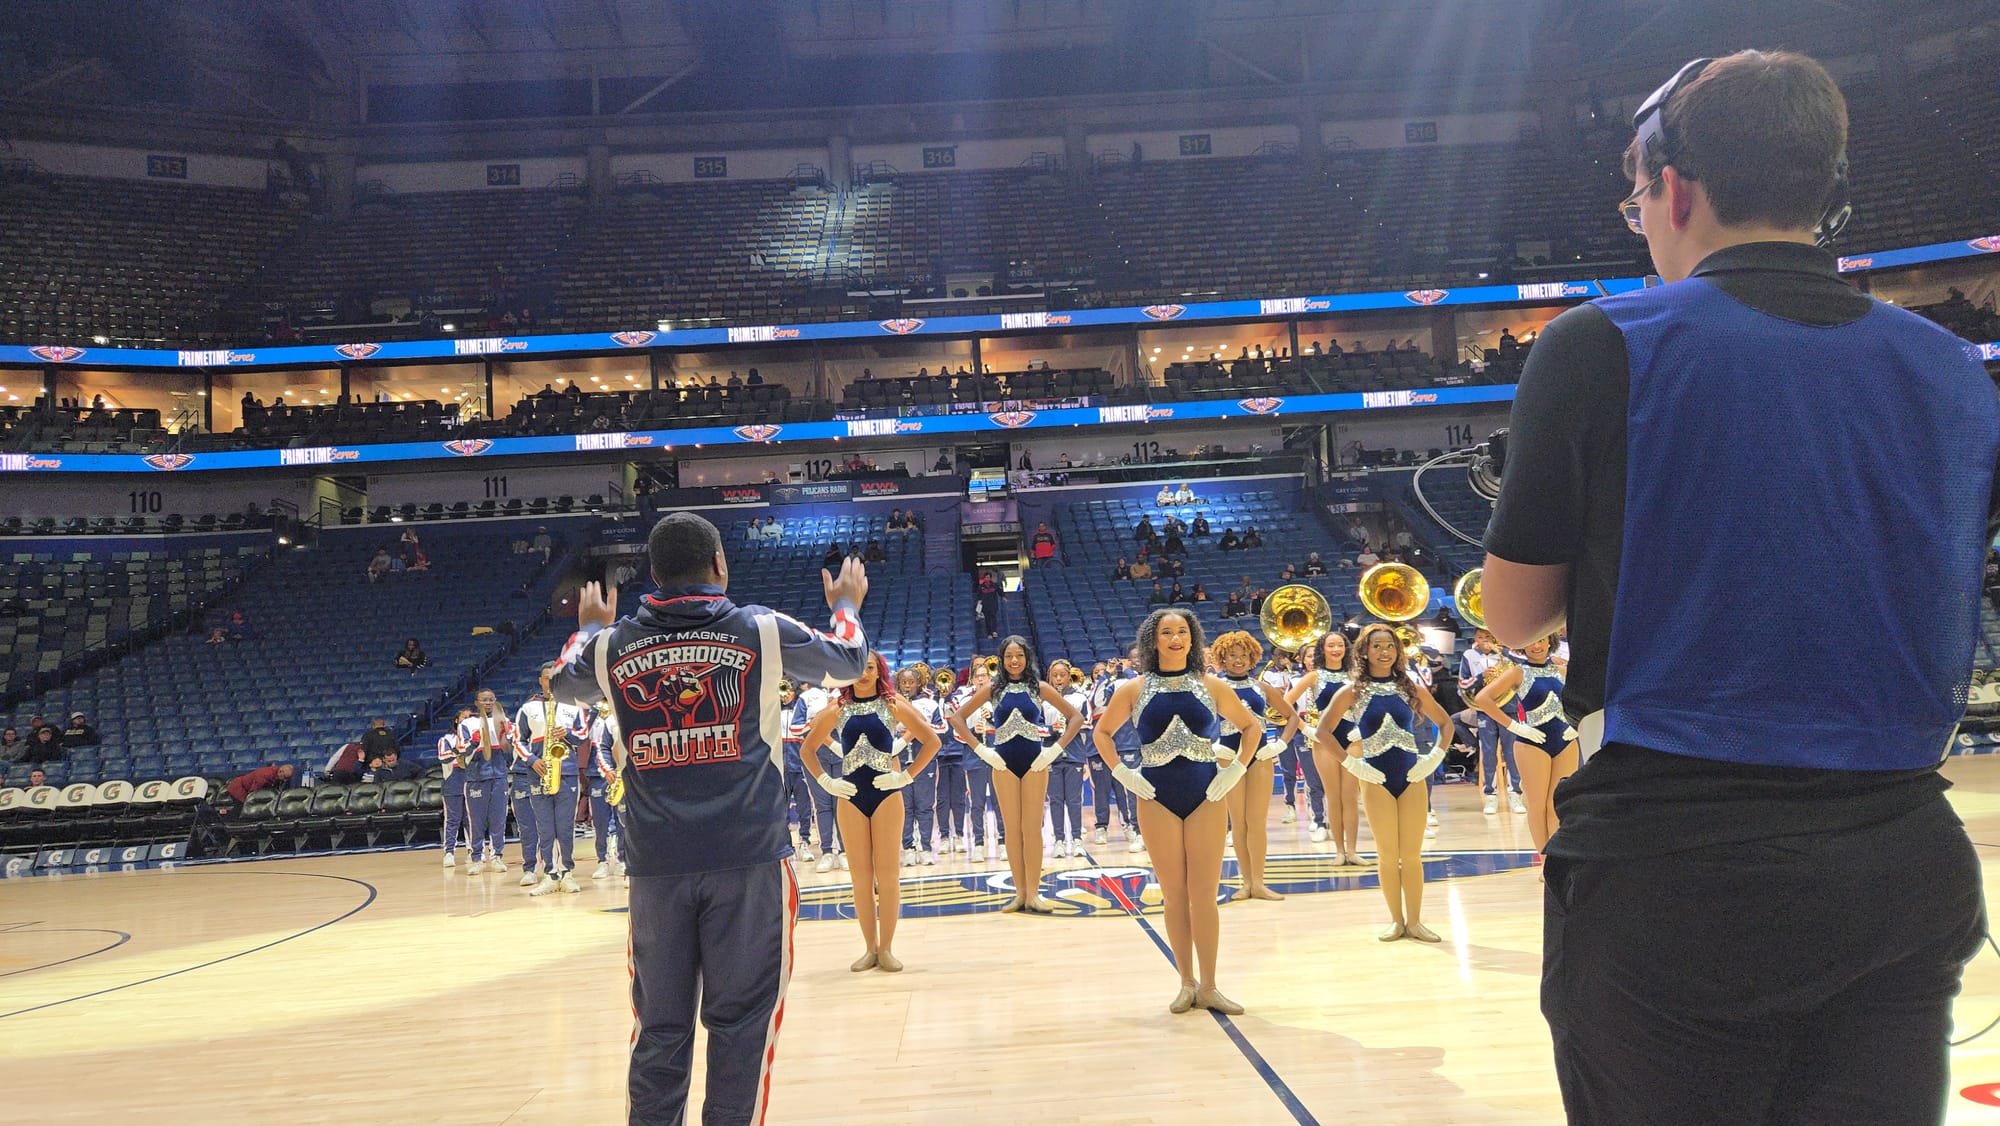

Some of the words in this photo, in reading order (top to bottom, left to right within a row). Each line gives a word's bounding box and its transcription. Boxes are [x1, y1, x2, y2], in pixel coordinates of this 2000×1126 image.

[1183, 137, 1208, 153] 317
[927, 148, 952, 164] 316
[152, 159, 183, 175] 313
[490, 167, 518, 183] 314
[698, 159, 724, 175] 315
[1518, 282, 1564, 299] PRIMETIME
[1261, 298, 1306, 314] PRIMETIME
[1002, 312, 1047, 328] PRIMETIME
[728, 326, 775, 342] PRIMETIME
[455, 338, 503, 354] PRIMETIME
[178, 350, 229, 366] PRIMETIME
[1363, 390, 1411, 408] PRIMETIME
[1099, 405, 1147, 423] PRIMETIME
[847, 418, 897, 436] PRIMETIME
[1445, 424, 1473, 445] 114
[576, 433, 626, 450] PRIMETIME
[280, 447, 331, 465] PRIMETIME
[1133, 441, 1160, 462] 113
[27, 456, 62, 469] Series
[804, 460, 832, 480] 112
[483, 476, 508, 498] 111
[128, 491, 162, 513] 110
[618, 633, 673, 657] LIBERTY
[676, 631, 738, 644] MAGNET
[613, 645, 752, 686] POWERHOUSE
[632, 724, 738, 766] SOUTH
[31, 787, 51, 804] G
[68, 785, 86, 803] G
[103, 782, 122, 800] G
[143, 782, 162, 799] G
[178, 778, 196, 796] G
